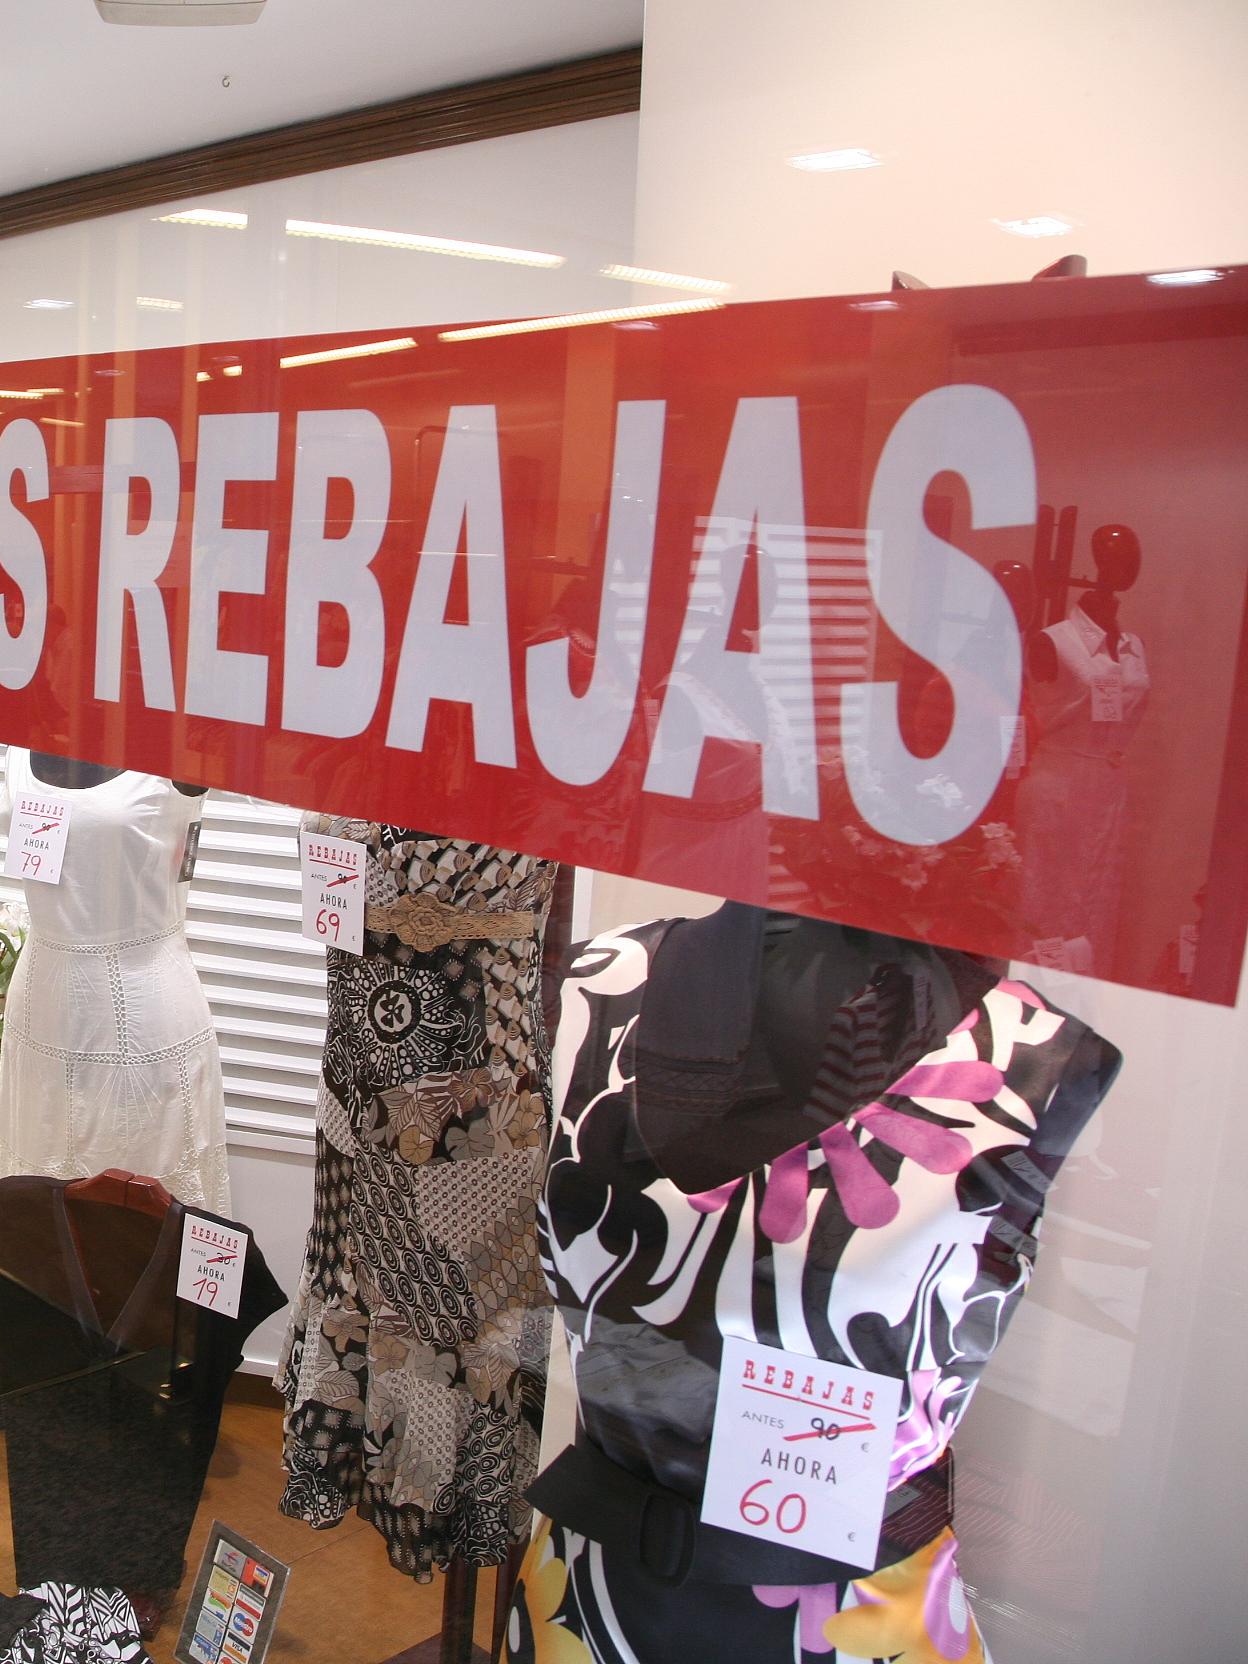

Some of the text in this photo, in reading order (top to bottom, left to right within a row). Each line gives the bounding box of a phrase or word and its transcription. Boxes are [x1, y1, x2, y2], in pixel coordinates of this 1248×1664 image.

[94, 383, 1038, 847] REBAJAS
[20, 800, 64, 816] REBAJAS
[23, 838, 49, 851] AHORA
[308, 844, 357, 866] REBAJAS
[20, 851, 42, 876] 79
[319, 892, 348, 910] AHORA
[316, 909, 341, 942] 69
[191, 1225, 239, 1250] REBAJAS
[196, 1264, 225, 1282] AHORA
[192, 1278, 218, 1307] 19
[743, 1359, 875, 1411] REBAJAS
[741, 1410, 870, 1452] ANTES 90 €
[761, 1447, 837, 1485] AHORA
[739, 1479, 807, 1534] 60
